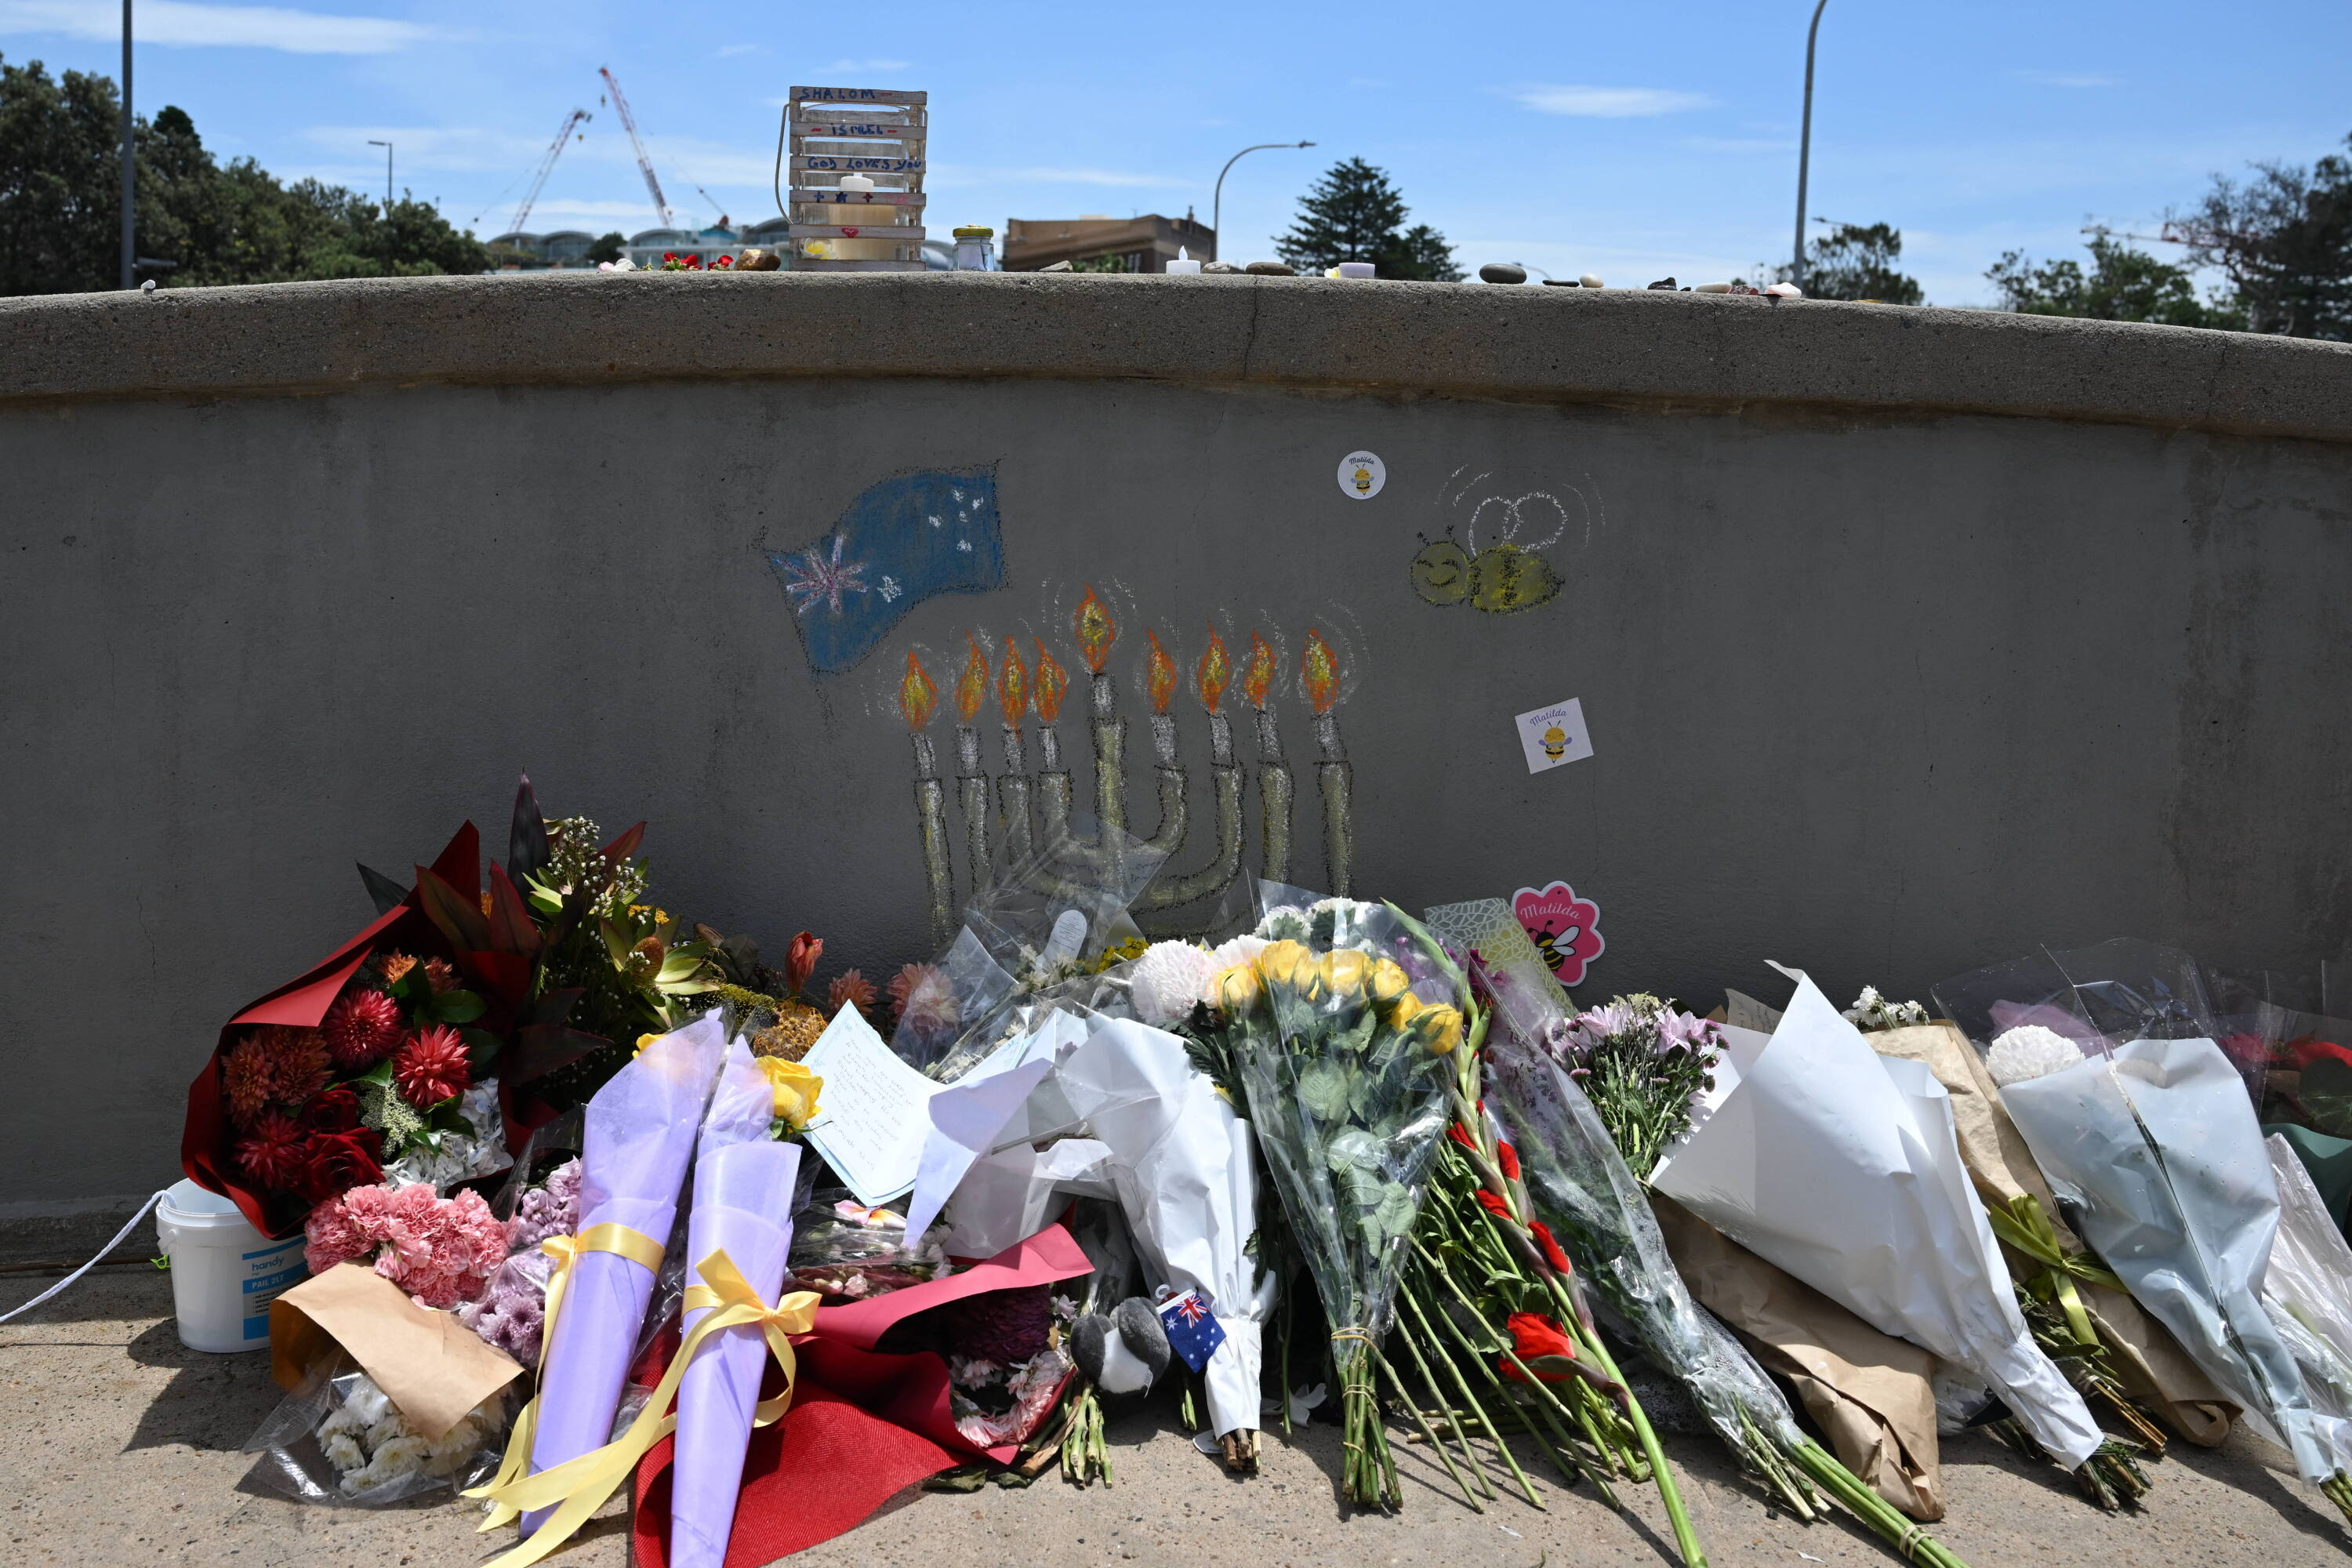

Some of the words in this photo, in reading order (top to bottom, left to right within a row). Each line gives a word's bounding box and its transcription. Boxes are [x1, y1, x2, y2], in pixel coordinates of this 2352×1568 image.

[799, 88, 876, 100] SHALOM
[1348, 456, 1374, 465] Matilda
[1530, 708, 1568, 726] Matilda
[1520, 902, 1581, 920] Matilda
[252, 1256, 284, 1271] handy
[252, 1279, 270, 1290] PAIL
